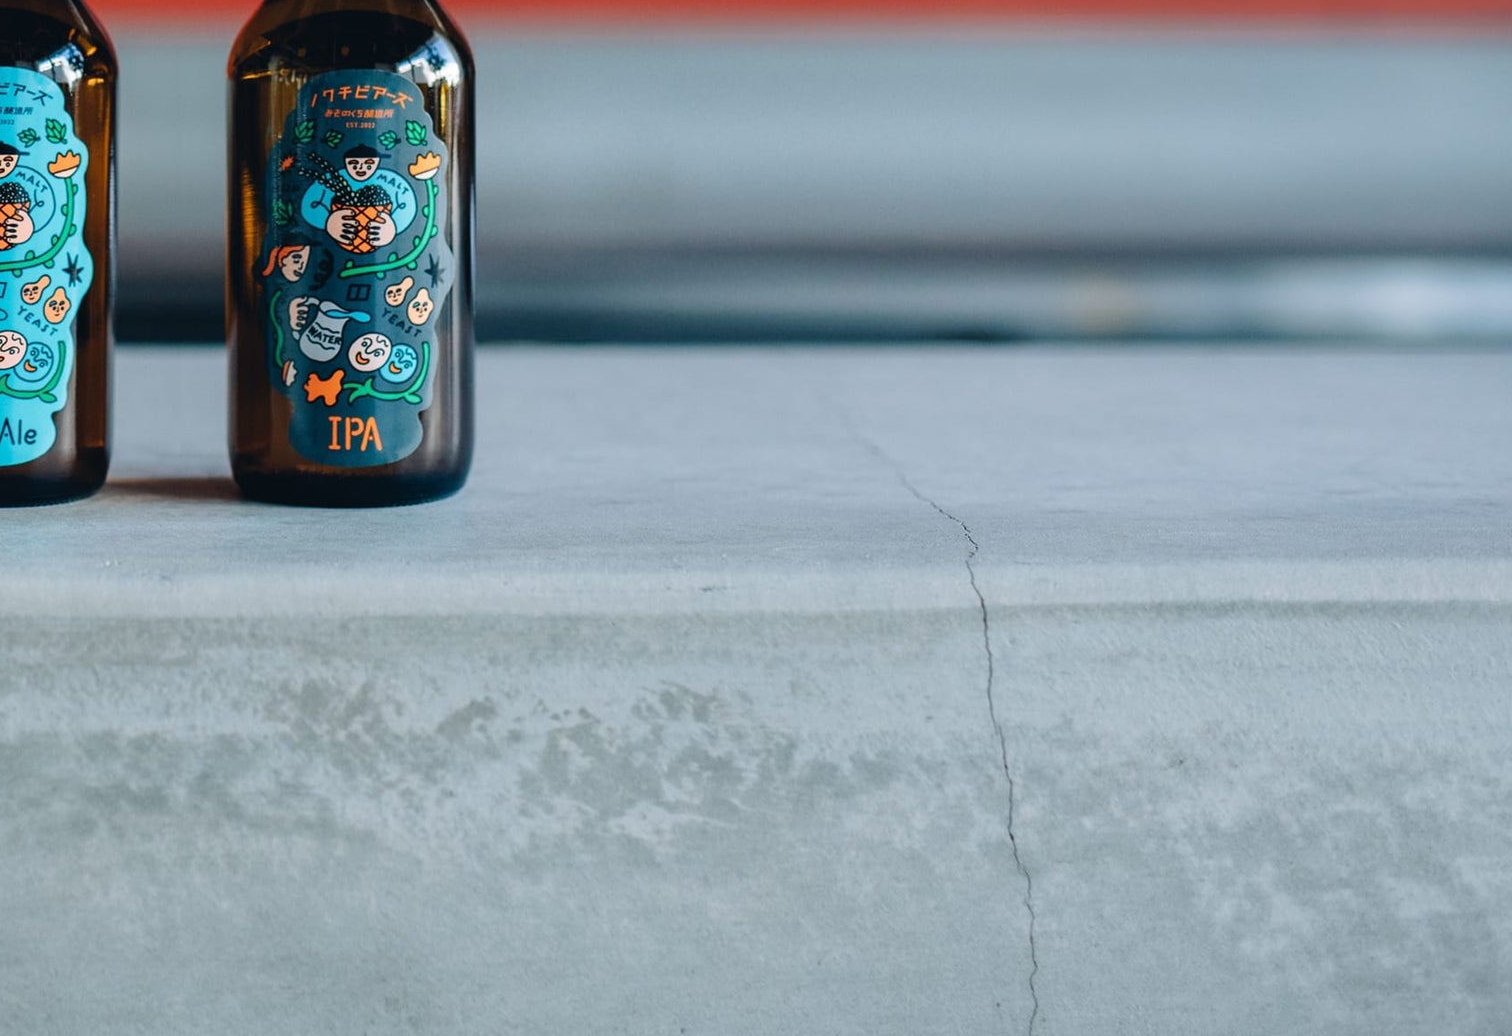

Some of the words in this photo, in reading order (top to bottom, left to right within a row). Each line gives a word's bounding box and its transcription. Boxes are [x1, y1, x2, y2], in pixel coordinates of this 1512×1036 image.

[16, 171, 48, 194] MALT
[376, 173, 409, 195] MALT
[18, 305, 58, 337] YEAST
[381, 308, 423, 338] YEAST
[307, 325, 342, 345] WATER
[328, 416, 383, 452] IPA
